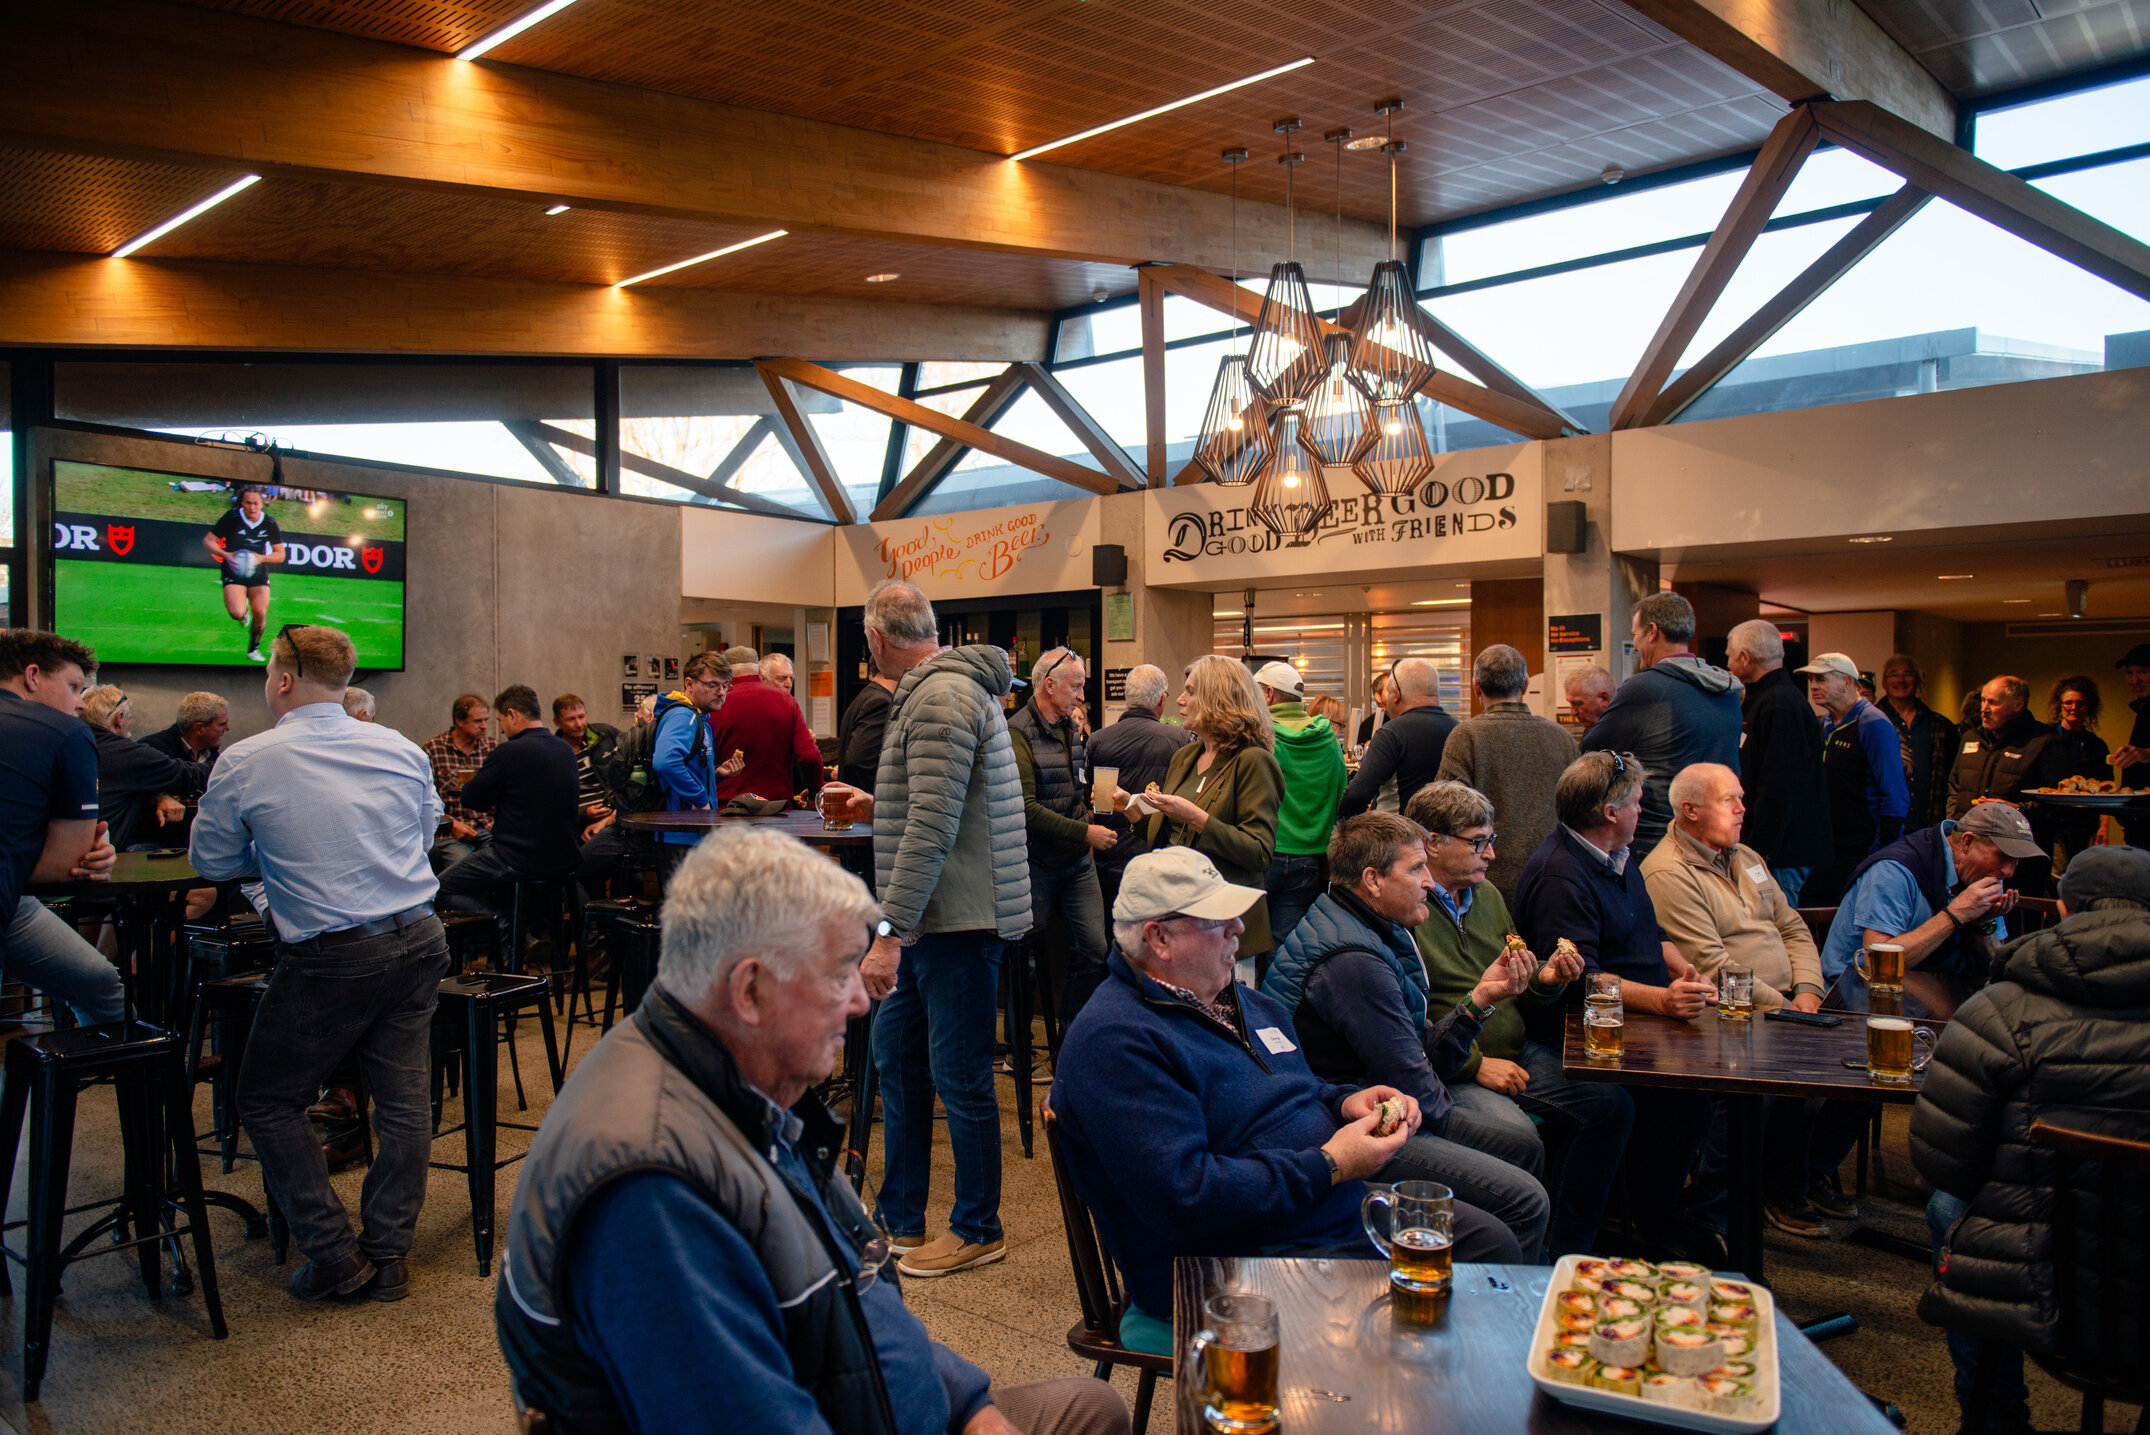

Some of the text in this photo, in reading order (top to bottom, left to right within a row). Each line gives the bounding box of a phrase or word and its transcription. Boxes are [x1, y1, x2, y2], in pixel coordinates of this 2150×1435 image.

[1390, 473, 1515, 515] GOOD
[966, 513, 1037, 549] DRINK GOOD
[1205, 506, 1517, 556] GOOD WITH FRIENDS
[902, 544, 961, 581] people
